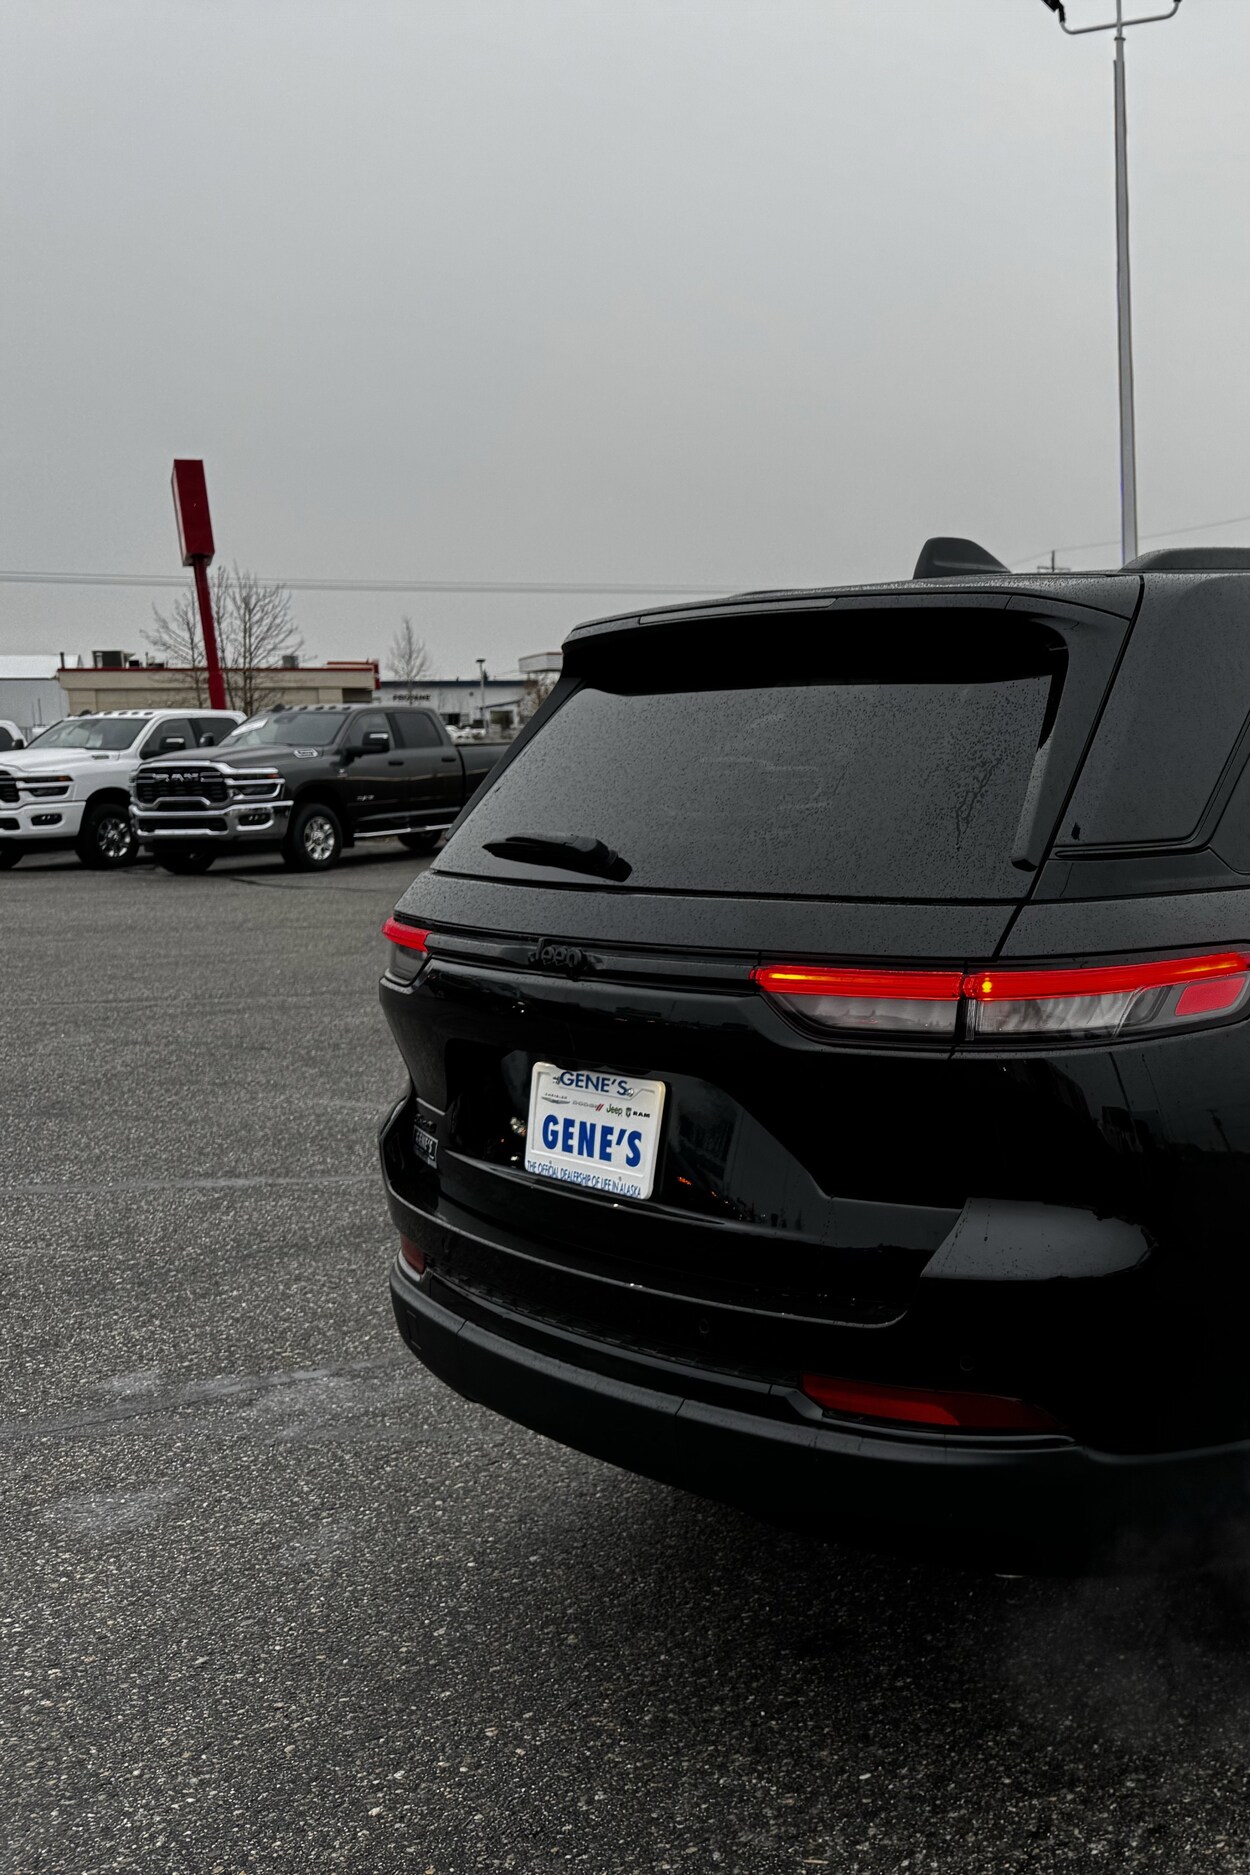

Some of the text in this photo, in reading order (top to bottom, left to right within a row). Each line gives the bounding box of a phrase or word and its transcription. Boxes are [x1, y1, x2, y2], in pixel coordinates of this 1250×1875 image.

[528, 937, 583, 973] Jeep
[560, 1071, 628, 1096] GENE'S
[607, 1104, 623, 1116] Jeep
[543, 1114, 642, 1167] GENE'S
[528, 1160, 641, 1196] THE OFFICIAL DEALERSHIP OF LIFE IN ALASKA
